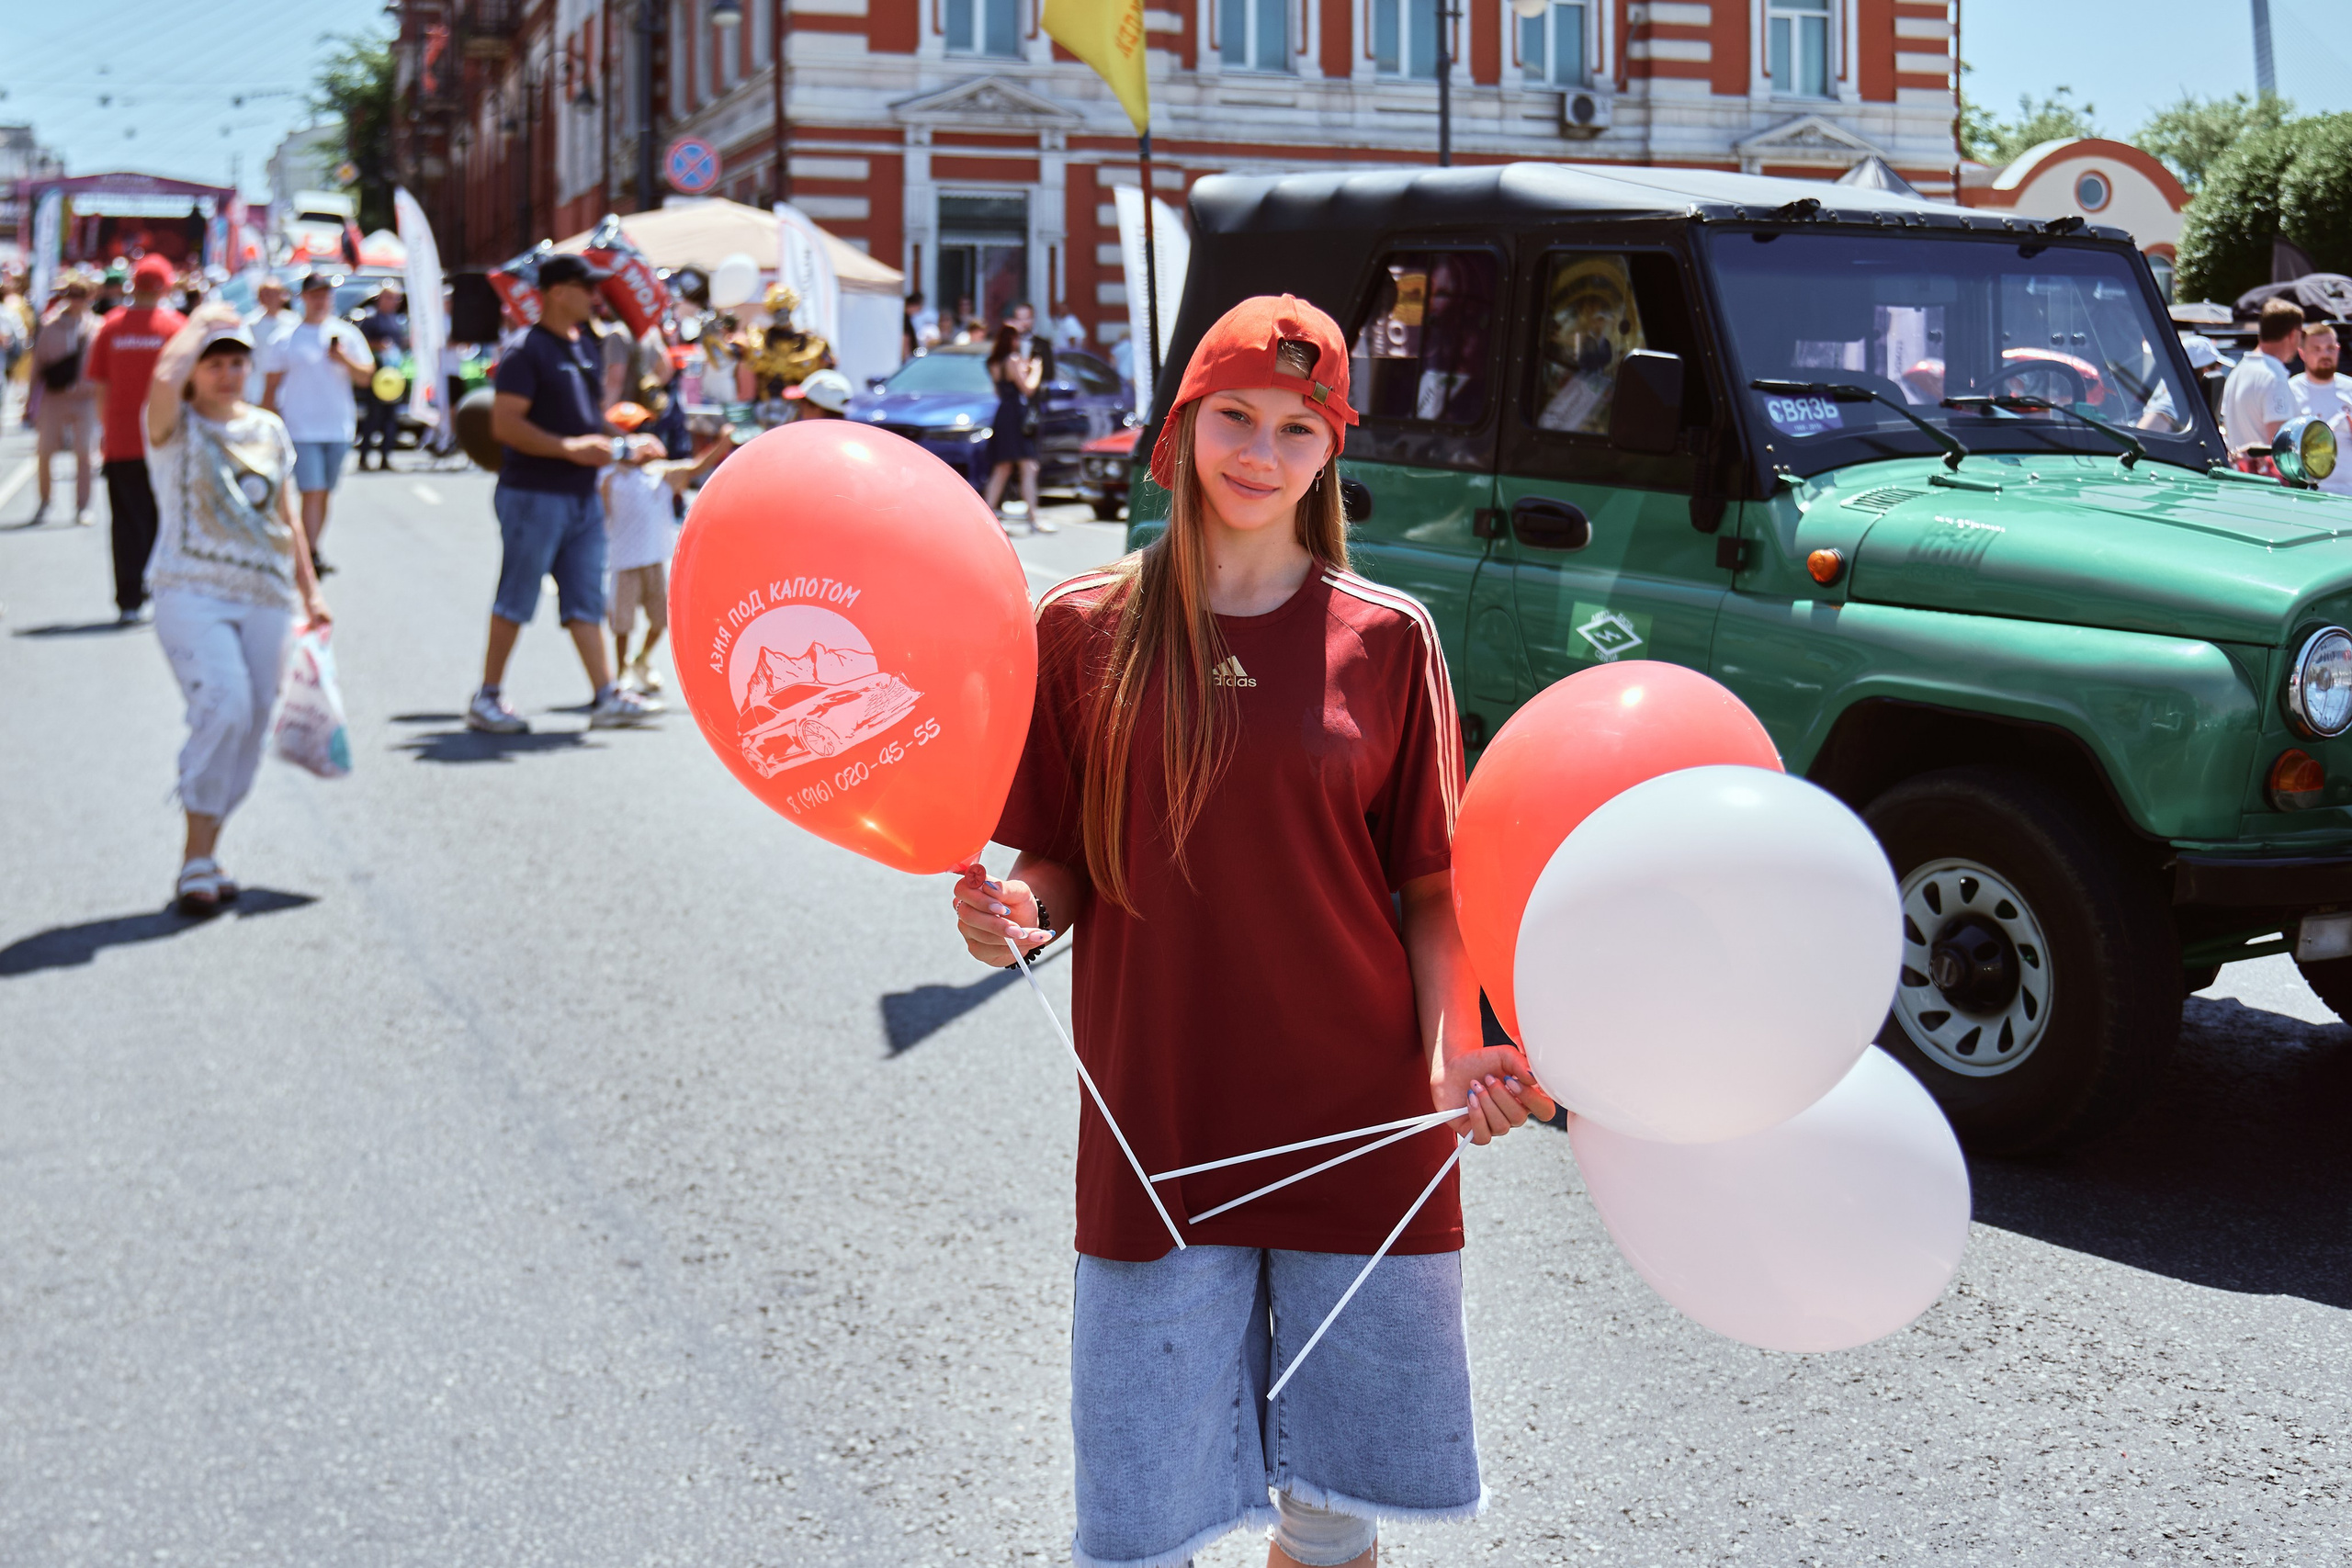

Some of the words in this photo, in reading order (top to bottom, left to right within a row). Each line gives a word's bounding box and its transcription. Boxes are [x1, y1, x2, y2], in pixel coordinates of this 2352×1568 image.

[709, 626, 732, 674] АЗИЯ
[728, 590, 766, 628] ПОД
[769, 577, 862, 608] КАПОТОМ
[786, 795, 801, 815] 8
[797, 780, 834, 809] (916)
